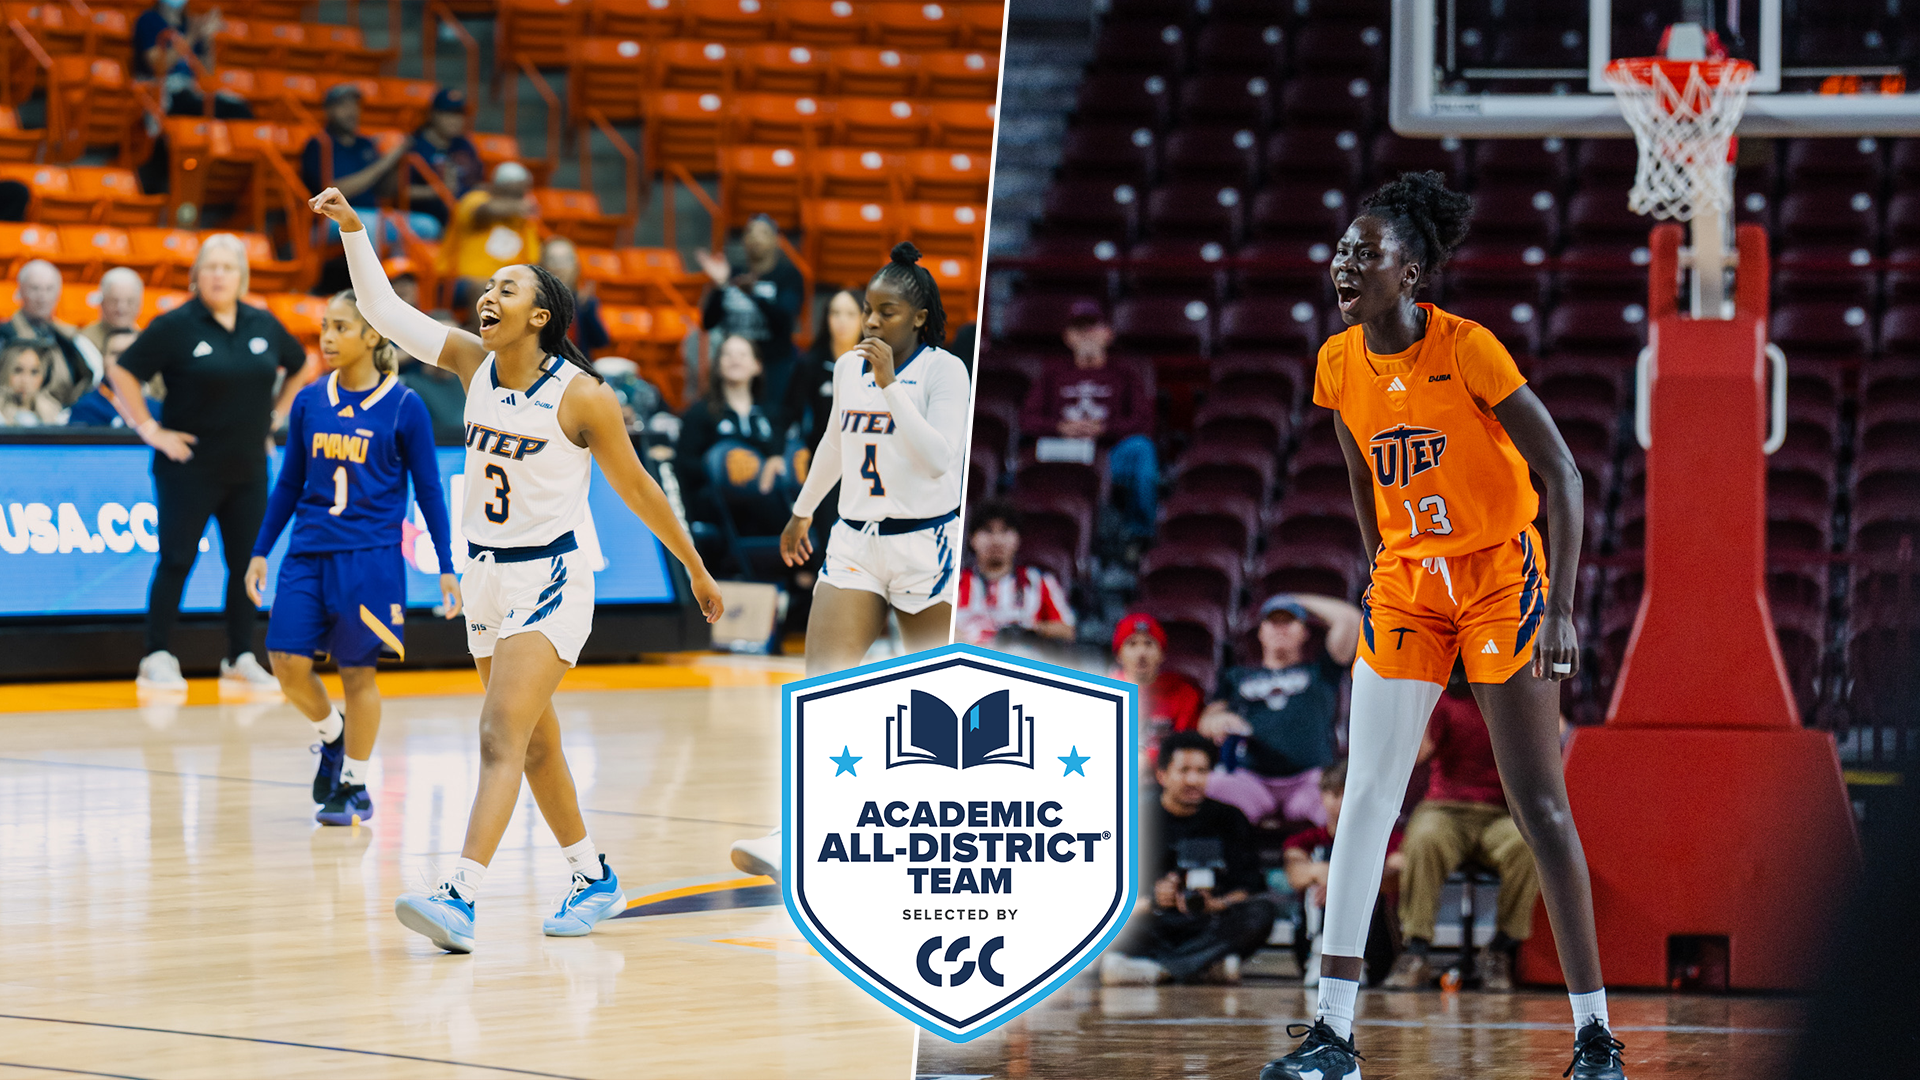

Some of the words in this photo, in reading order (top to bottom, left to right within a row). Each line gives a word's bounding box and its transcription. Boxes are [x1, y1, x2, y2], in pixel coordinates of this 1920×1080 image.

[312, 432, 369, 464] PVAMU
[860, 443, 886, 497] 4
[1369, 423, 1447, 489] UTEP
[328, 466, 348, 516] 1
[484, 462, 512, 525] 3
[1403, 494, 1453, 538] 13
